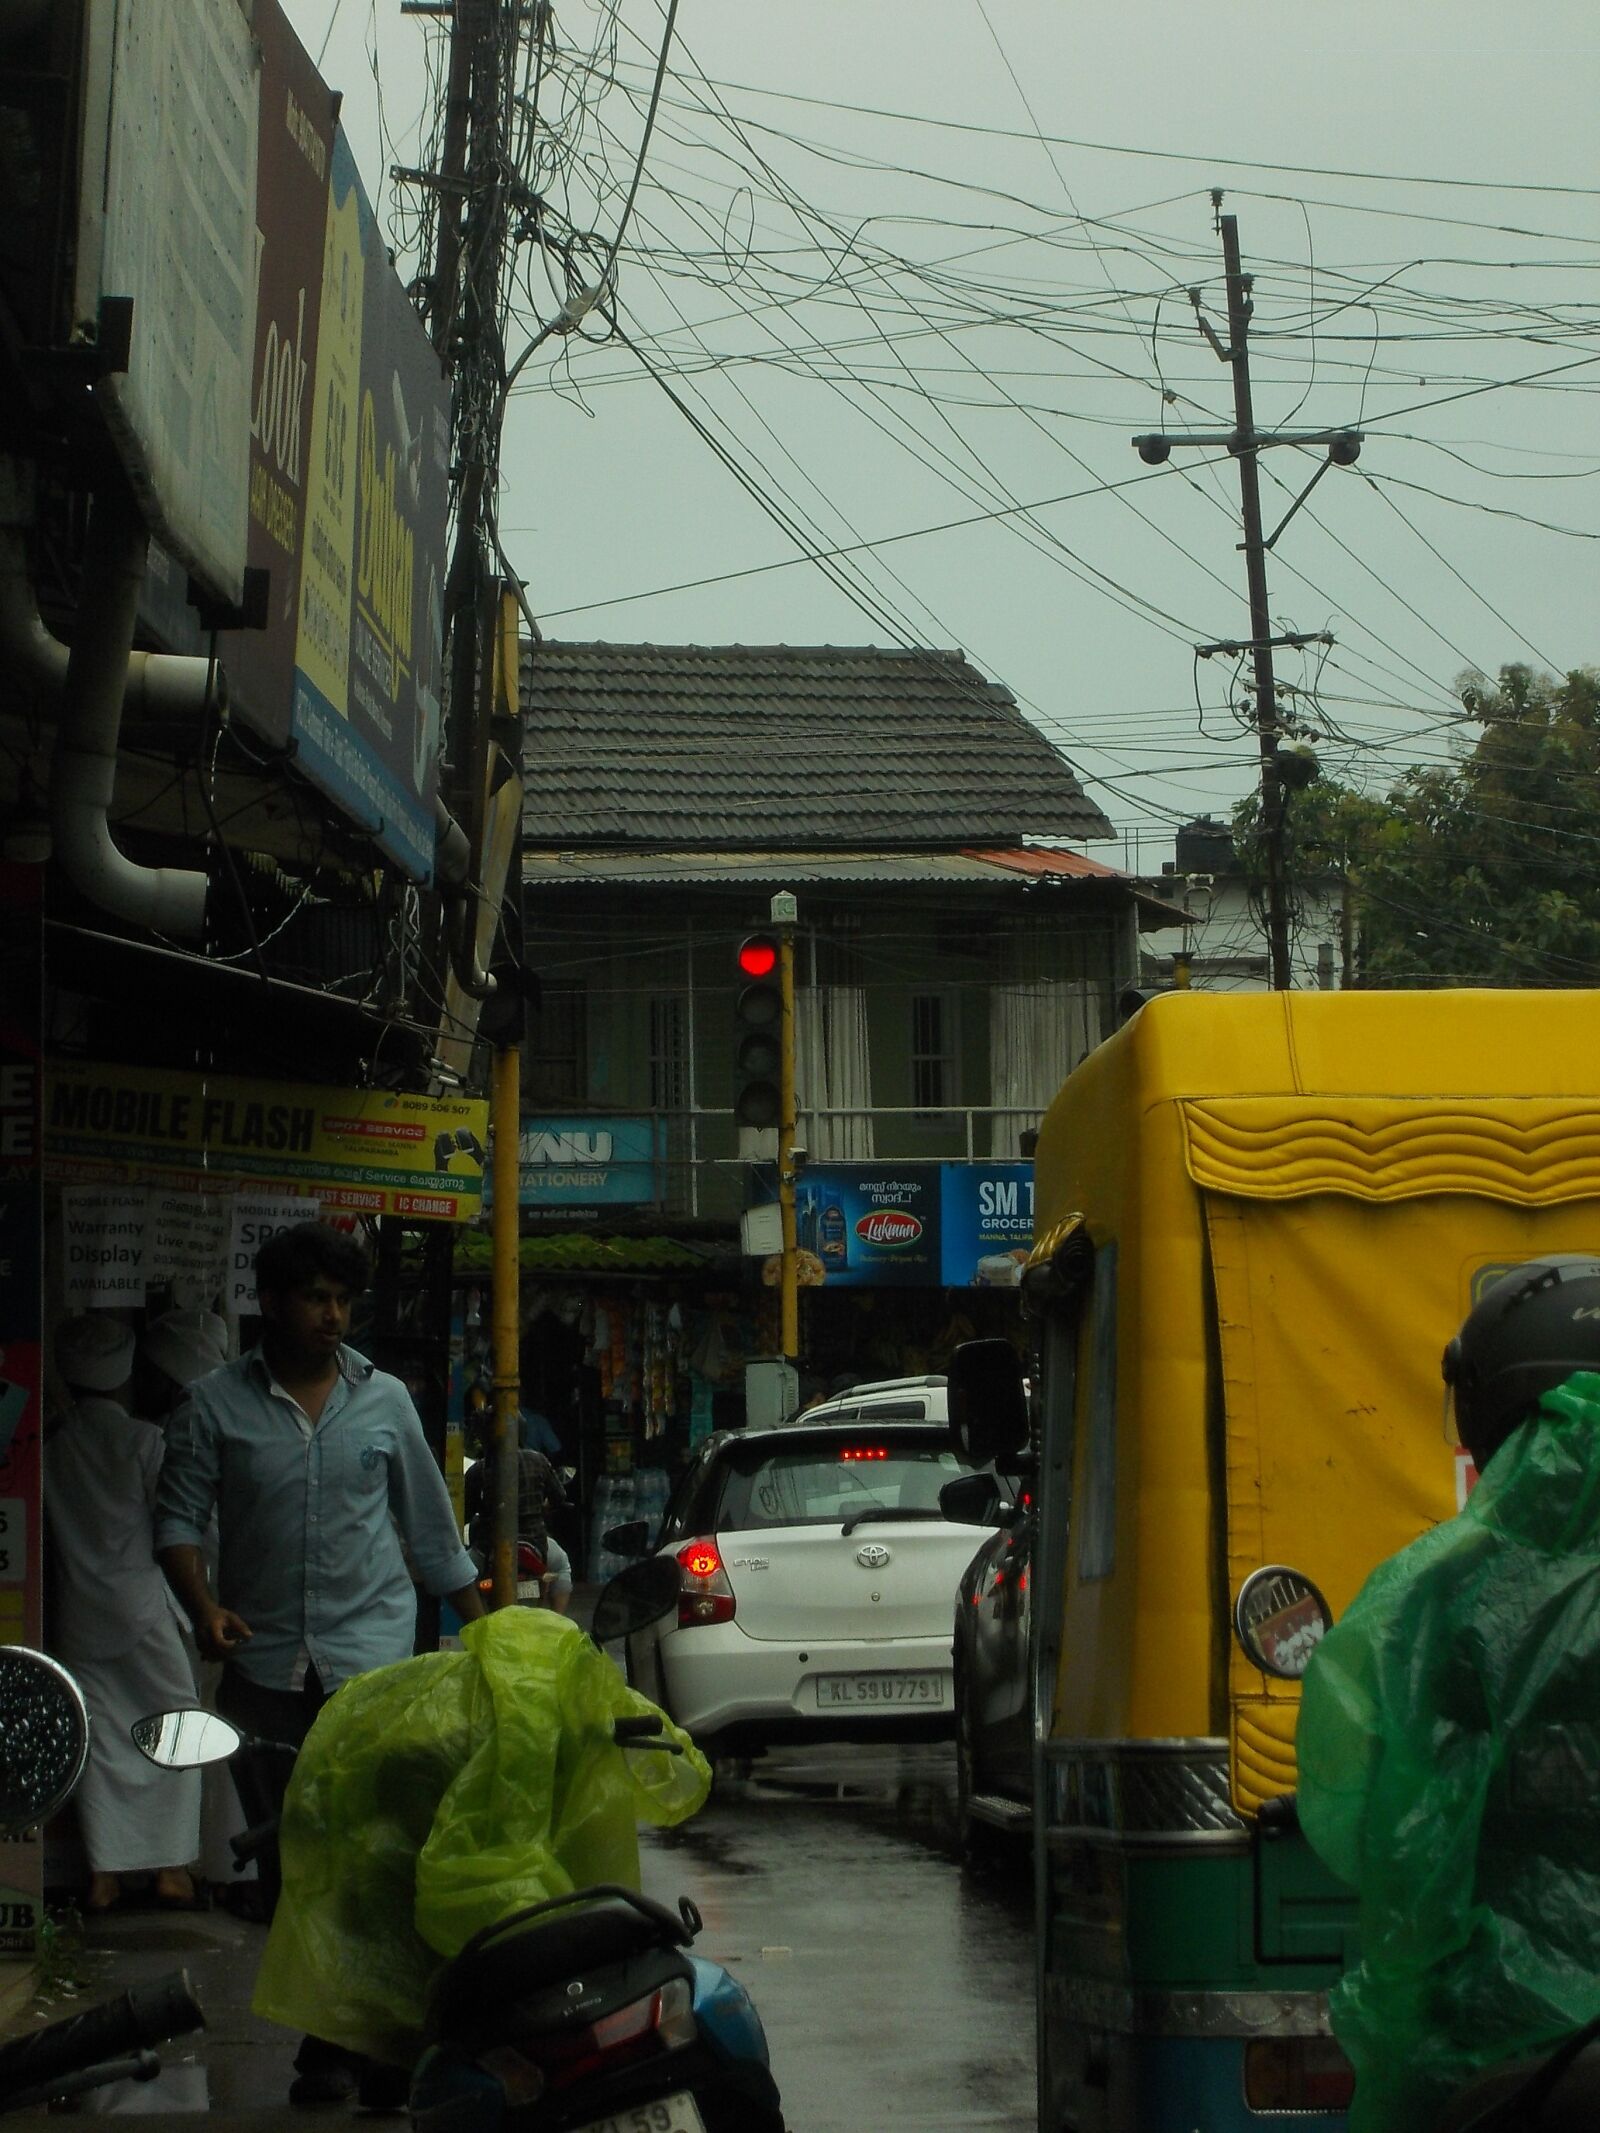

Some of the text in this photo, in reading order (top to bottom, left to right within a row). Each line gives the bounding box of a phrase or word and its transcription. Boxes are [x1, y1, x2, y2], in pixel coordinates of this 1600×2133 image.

[402, 1101, 471, 1115] 8089 506 507
[50, 1082, 316, 1153] MOBILE FLASH
[324, 1119, 425, 1137] SPOT SERVICE
[520, 1132, 613, 1162] NU
[366, 1169, 407, 1184] Service
[68, 1196, 144, 1207] MOBILE FLASH
[314, 1188, 382, 1208] FAST SERVICE
[399, 1196, 453, 1214] IC CHANGE
[978, 1181, 1018, 1215] SM
[237, 1206, 315, 1218] MOBILE FLASH
[68, 1221, 144, 1237] Warranty
[860, 1215, 916, 1241] Lukman
[981, 1218, 1035, 1229] GROCER
[156, 1233, 184, 1248] Live
[70, 1244, 143, 1266] Display
[69, 1278, 141, 1290] AVAILABLE
[830, 1682, 852, 1701] KL
